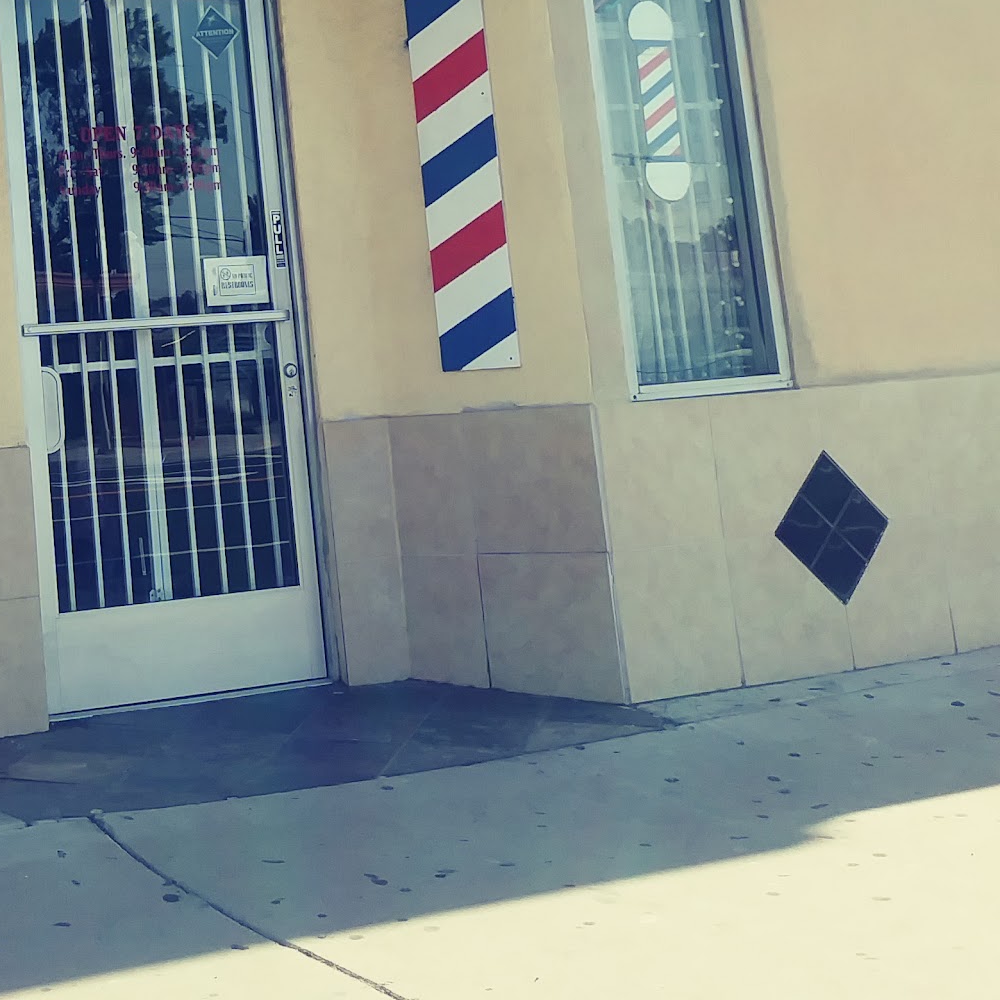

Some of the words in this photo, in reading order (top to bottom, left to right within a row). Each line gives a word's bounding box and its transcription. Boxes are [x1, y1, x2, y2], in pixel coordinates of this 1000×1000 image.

[195, 28, 235, 37] ATTENTION
[80, 125, 127, 143] OPEN
[133, 125, 144, 140] 7
[149, 123, 197, 140] DAYS
[272, 214, 284, 255] PULL
